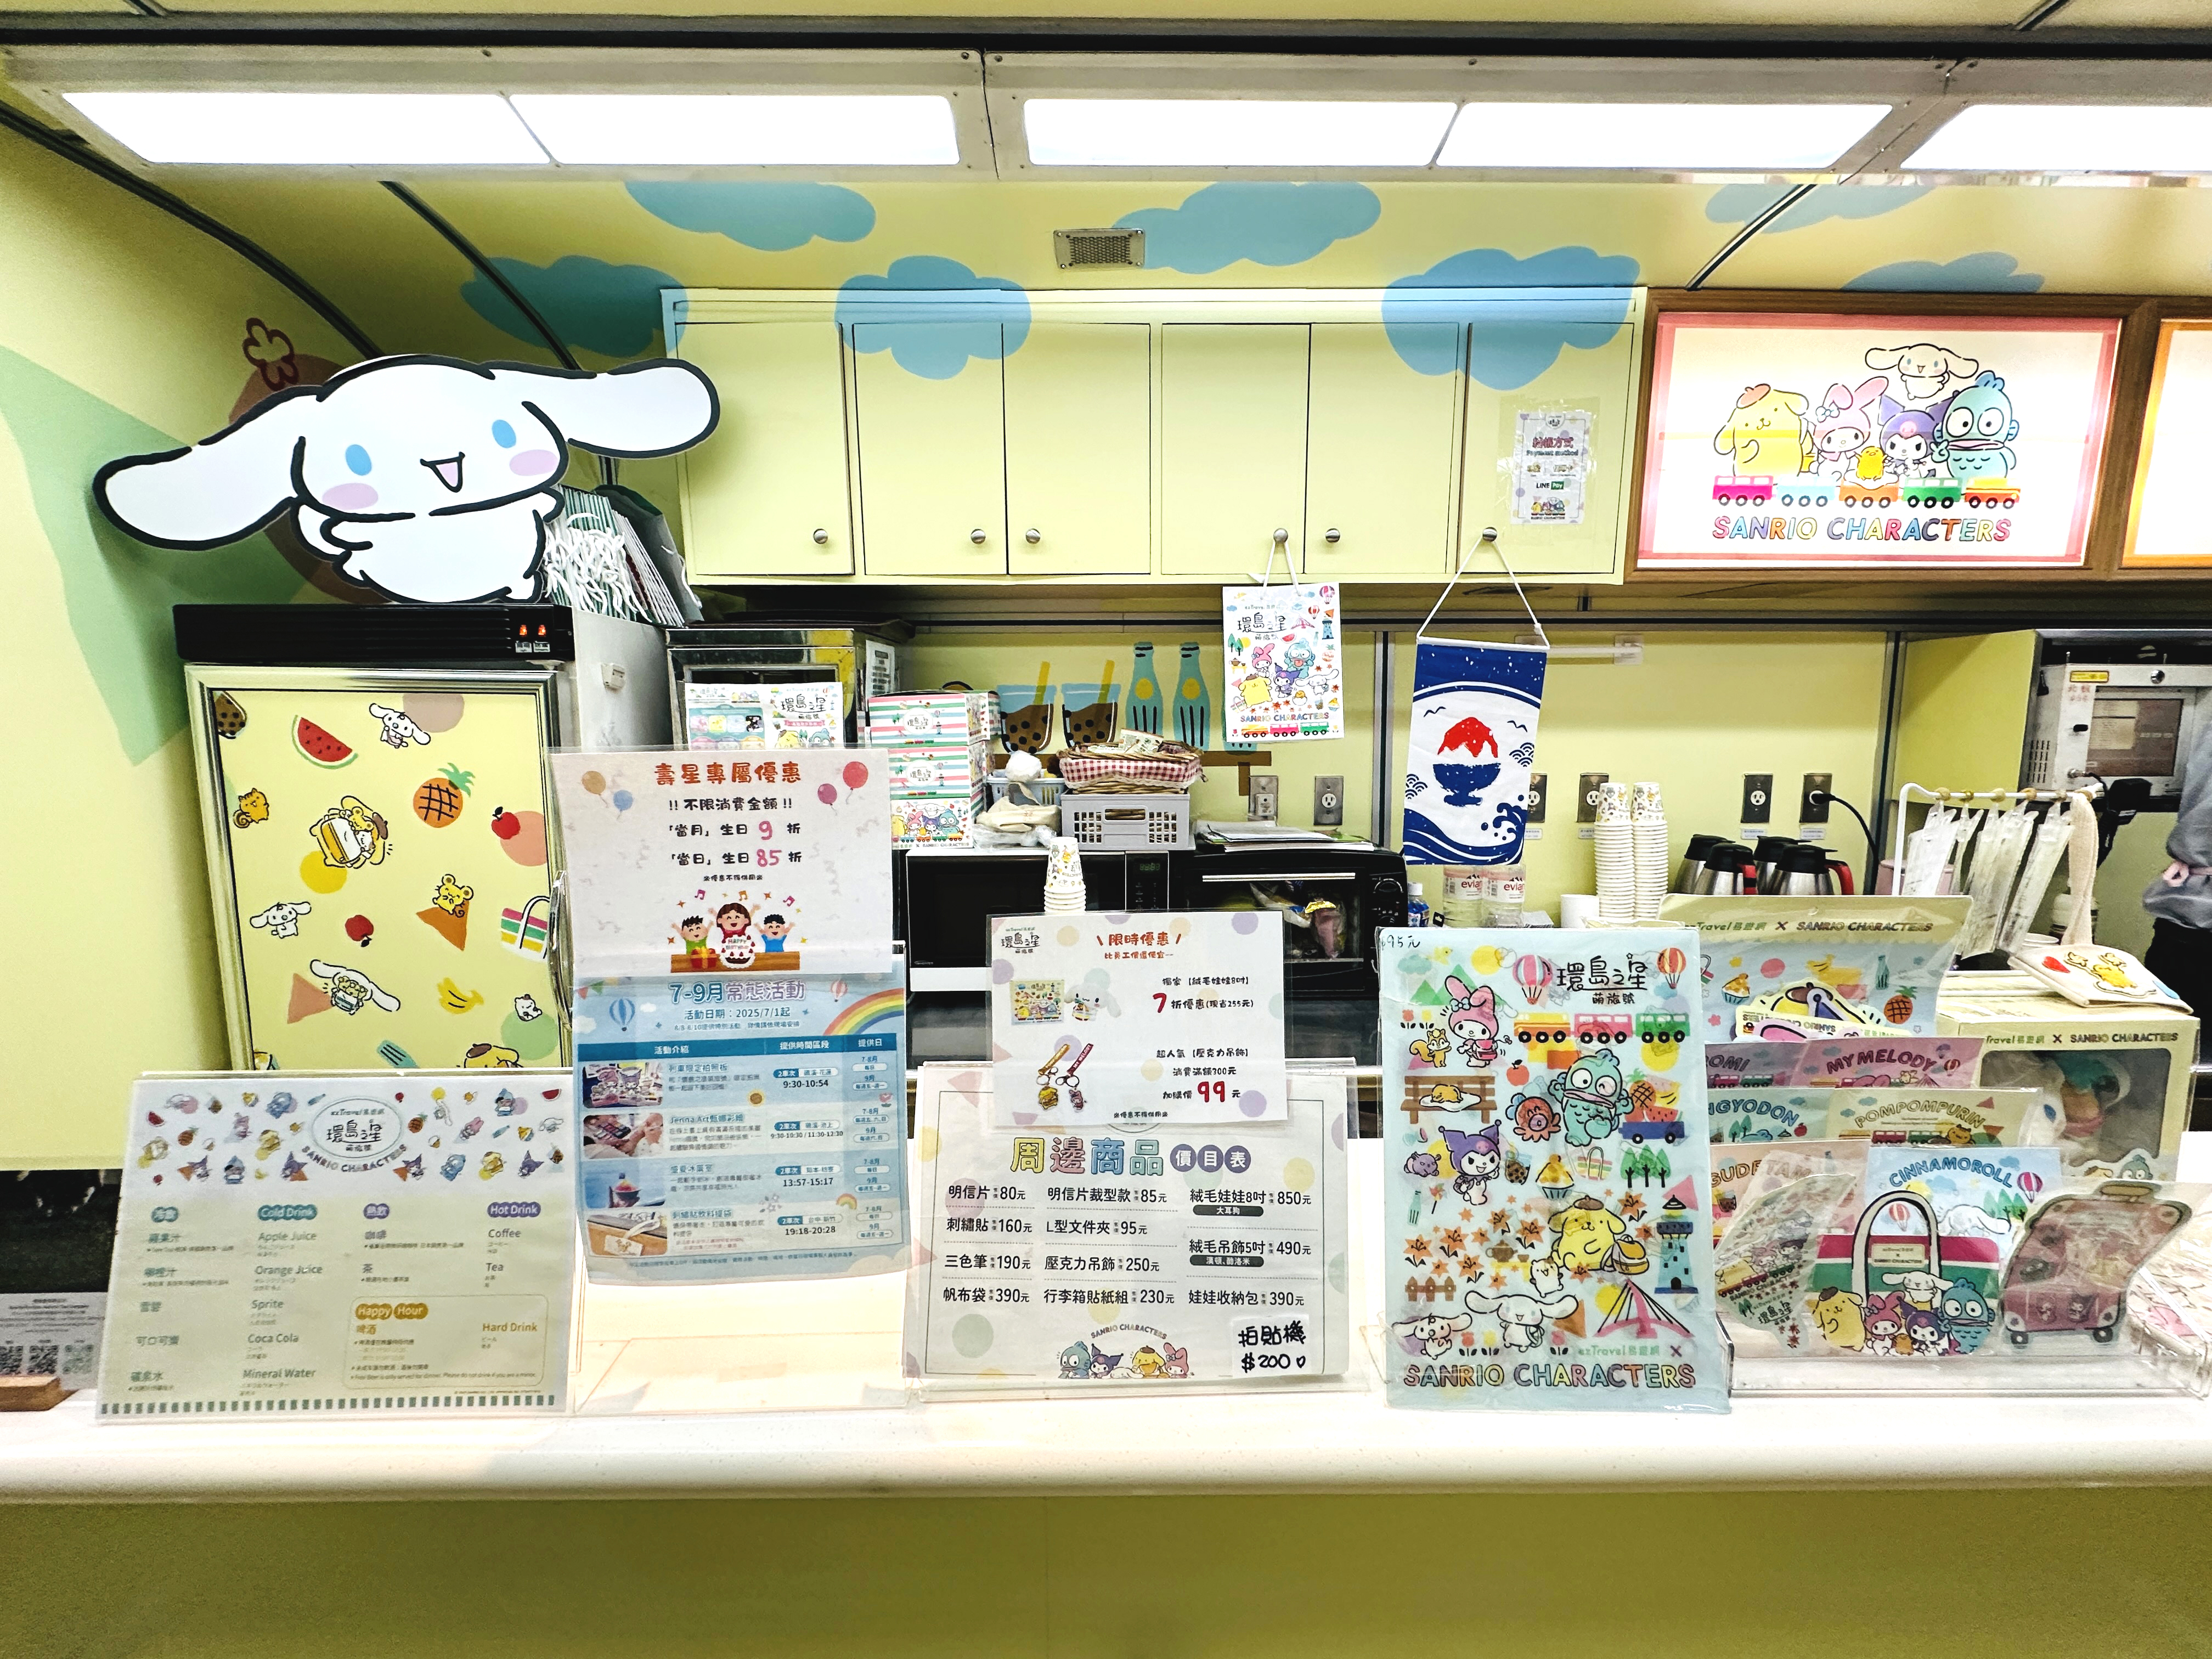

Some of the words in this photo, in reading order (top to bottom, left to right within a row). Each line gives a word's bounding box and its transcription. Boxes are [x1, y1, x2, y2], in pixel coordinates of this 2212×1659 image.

[1713, 516, 1818, 540] SANRIO
[1827, 517, 2012, 542] CHARACTERS
[1274, 713, 1329, 721] CHARACTERS
[654, 761, 802, 786] 壽星專屬優惠
[684, 797, 778, 811] 不限消費金額
[720, 823, 748, 837] 生日
[758, 821, 773, 840] 9
[787, 822, 801, 834] 折
[722, 851, 749, 865] 生日
[757, 849, 782, 867] 85
[788, 851, 802, 864] 折
[1796, 921, 1845, 932] SANRIO
[1848, 921, 1933, 933] CHARACTERS
[1001, 932, 1040, 948] 環島之星
[1108, 932, 1170, 946] 限時優惠
[1556, 952, 1647, 991] 環島之星
[1162, 977, 1181, 986] 獨家
[669, 979, 806, 1004] 7-9月常態活動
[1592, 992, 1635, 1005] 萌旅號
[1153, 992, 1167, 1014] 7
[2070, 1034, 2109, 1043] SANRIO
[2112, 1032, 2179, 1042] CHARACTERS
[654, 1045, 689, 1054] 活動介紹
[780, 1040, 830, 1050] 提供時間區段
[858, 1039, 883, 1047] 提供日
[1156, 1048, 1186, 1059] 超人氣
[1706, 1054, 1750, 1072] OMI
[1826, 1054, 1853, 1074] MY
[1858, 1049, 1938, 1073] MELODY
[783, 1080, 828, 1088] 9:30-10:54
[1197, 1080, 1226, 1103] 99
[1231, 1089, 1242, 1099] 元
[1855, 1100, 1987, 1128] POMPOMPURIN
[326, 1119, 382, 1143] 環島之星
[1010, 1137, 1164, 1176] 周邊商品
[1175, 1149, 1246, 1170] 價目表
[1889, 1156, 2012, 1188] CINNAMOROLL
[783, 1178, 833, 1187] 13:57-15:17
[949, 1185, 990, 1201] 明信片
[1000, 1186, 1026, 1201] 80元
[1047, 1187, 1131, 1203] 明信片裁型款
[1141, 1189, 1167, 1203] 85元
[1189, 1188, 1266, 1204] 絨毛娃娃8吋
[1277, 1191, 1311, 1205] 850元
[261, 1207, 284, 1217] Cold
[286, 1207, 315, 1217] Drink
[490, 1206, 508, 1216] Hot
[510, 1205, 538, 1215] Drink
[1216, 1206, 1240, 1215] 大耳狗
[785, 1226, 836, 1235] 19:18-20:28
[946, 1217, 989, 1232] 刺繡貼
[998, 1218, 1032, 1233] 160元
[1046, 1220, 1110, 1235] L型文件夾
[1121, 1221, 1147, 1235] 95元
[258, 1232, 288, 1243] Apple
[290, 1232, 317, 1242] Juice
[488, 1229, 521, 1238] Coffee
[1189, 1239, 1266, 1255] 絨毛吊飾5吋
[1277, 1241, 1311, 1255] 490元
[255, 1266, 292, 1277] Orange
[295, 1265, 323, 1274] Juice
[363, 1263, 373, 1273] 茶
[487, 1263, 504, 1272] Tea
[944, 1254, 987, 1269] 三色筆
[997, 1256, 1031, 1270] 190元
[1045, 1256, 1115, 1272] 壓克力吊飾
[1126, 1257, 1160, 1272] 250元
[943, 1287, 986, 1302] 帆布袋
[995, 1288, 1030, 1303] 390元
[1043, 1289, 1128, 1305] 行李箱貼紙組
[1140, 1289, 1175, 1304] 230元
[1188, 1290, 1259, 1306] 娃娃收納包
[1269, 1291, 1305, 1306] 390元
[251, 1300, 284, 1310] Sprite
[358, 1306, 392, 1318] Happy
[397, 1306, 424, 1316] Hour
[136, 1335, 179, 1346] 可口可樂
[248, 1334, 274, 1344] Coca
[276, 1333, 299, 1343] Cola
[483, 1322, 507, 1331] Hard
[510, 1322, 538, 1331] Drink
[1091, 1324, 1118, 1339] SANRIO
[1119, 1323, 1167, 1340] CHARACTERS
[1238, 1320, 1307, 1347] 拍貼機
[1241, 1352, 1291, 1374] $200
[243, 1369, 282, 1379] Mineral
[284, 1369, 317, 1378] Water
[1403, 1363, 1505, 1389] SANRIO
[1513, 1363, 1697, 1389] CHARACTERS
